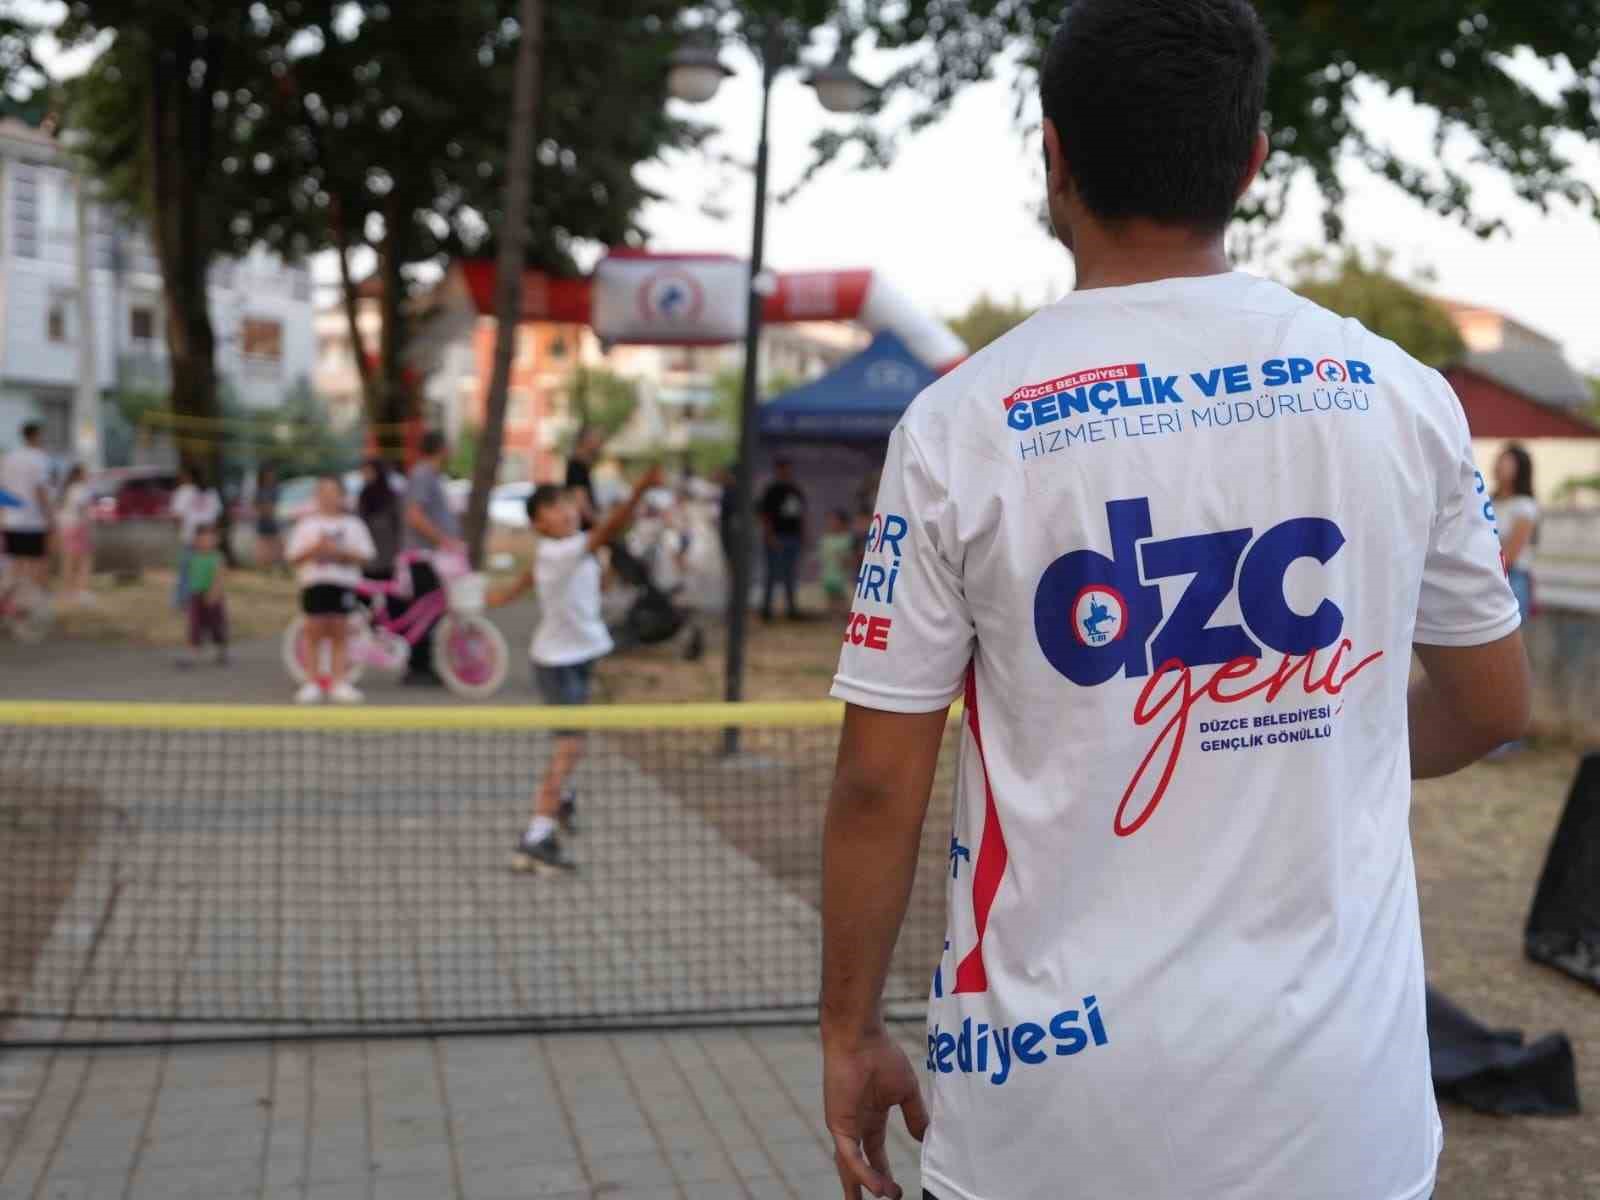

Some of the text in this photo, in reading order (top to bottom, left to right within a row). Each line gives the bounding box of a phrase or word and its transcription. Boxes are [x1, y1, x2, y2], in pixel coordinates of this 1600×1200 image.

[1056, 366, 1128, 390] BELEDİYESİ
[1190, 364, 1252, 397] VE
[1262, 357, 1376, 387] SPOR
[1020, 386, 1369, 460] HİZMETLERİ MÜDÜRLÜĞÜ
[1034, 496, 1346, 687] dzc
[1199, 704, 1331, 733] DÜZCE BELEDİYESİ
[1201, 725, 1332, 752] GENÇLİK GÖNÜLLÜ
